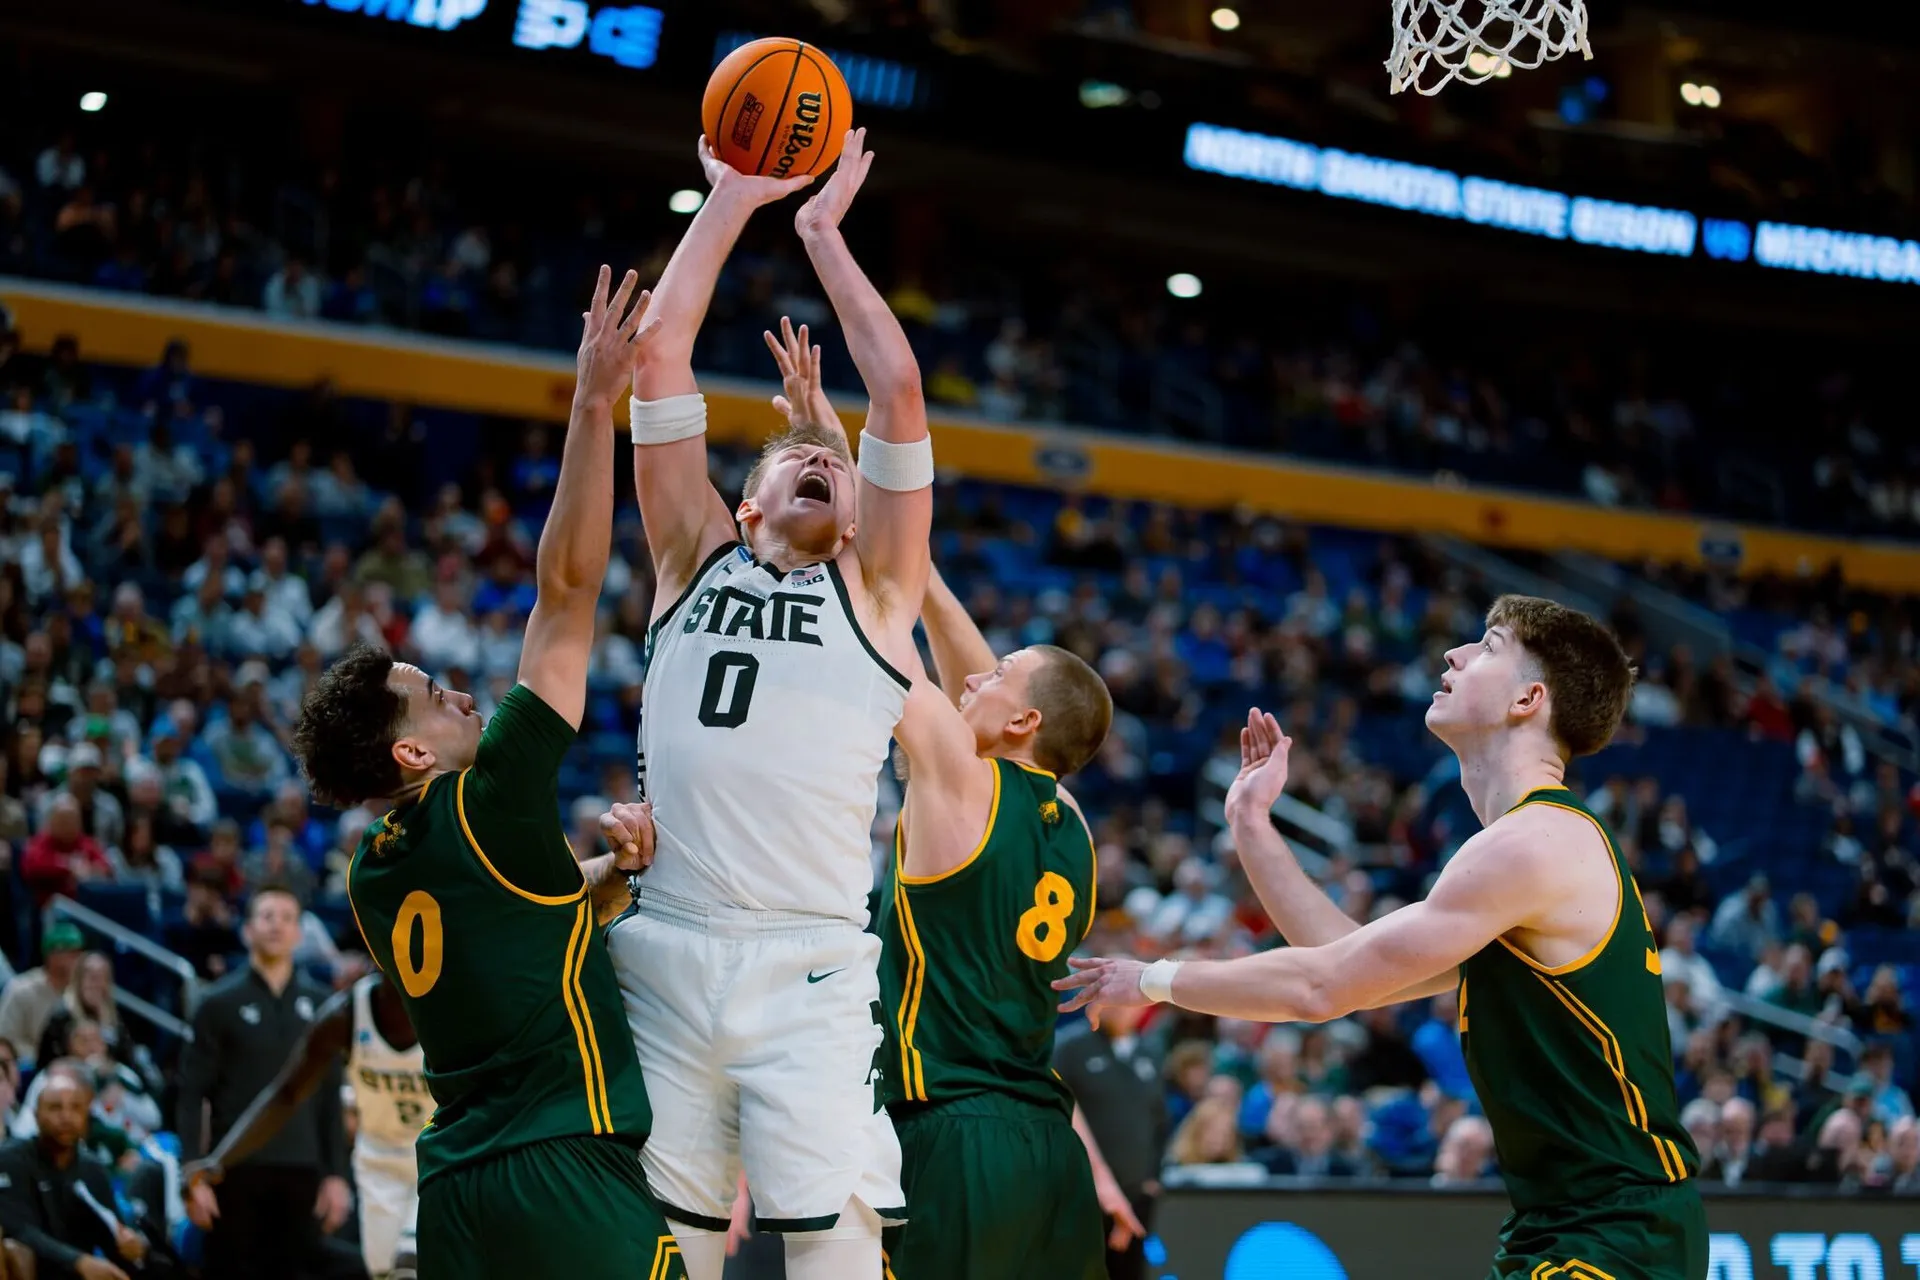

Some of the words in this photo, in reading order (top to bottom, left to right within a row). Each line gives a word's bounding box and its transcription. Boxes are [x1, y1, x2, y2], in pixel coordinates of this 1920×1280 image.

[768, 91, 821, 179] Wilson
[1184, 121, 1320, 191] NORTH
[1318, 147, 1461, 219] DAKOTA
[1460, 175, 1569, 240] STATE
[1569, 195, 1697, 257] BISON
[683, 585, 826, 647] STATE
[698, 650, 760, 728] 0
[391, 889, 443, 998] 0
[1016, 871, 1075, 962] 8
